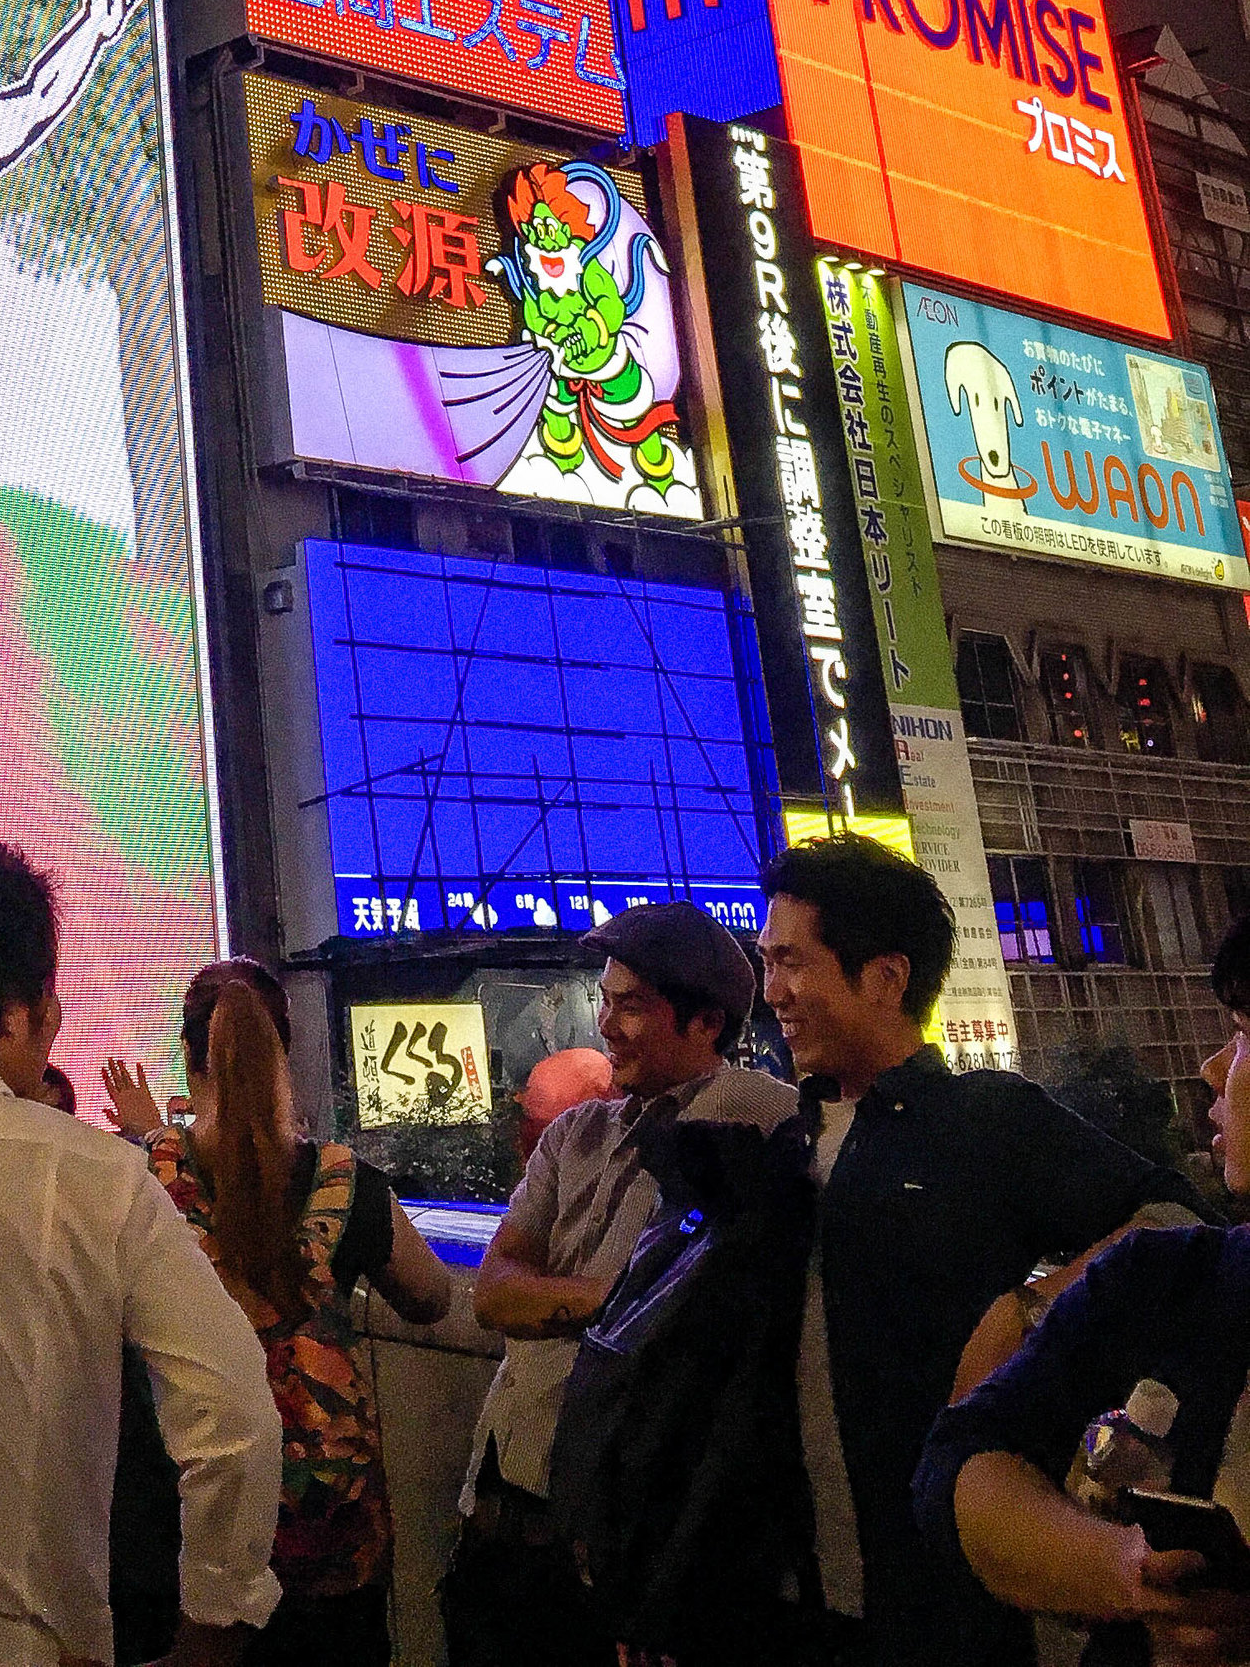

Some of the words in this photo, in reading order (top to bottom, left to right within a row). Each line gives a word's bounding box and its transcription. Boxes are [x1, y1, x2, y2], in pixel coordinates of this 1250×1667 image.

[290, 98, 460, 194] かぜに
[1015, 97, 1127, 184] プロミス
[276, 175, 490, 309] 改源
[1021, 338, 1106, 377] お買物のたびに
[861, 284, 923, 598] 不動産再生のスペシャリスト
[1034, 406, 1132, 445] おトクな電子マネー
[825, 278, 911, 692] 株式会社日本リート
[1040, 440, 1206, 537] WAON
[890, 714, 954, 742] NIHON
[893, 738, 925, 763] Real
[900, 764, 937, 789] Estate
[902, 788, 956, 815] Investment
[914, 840, 950, 856] ERVICE
